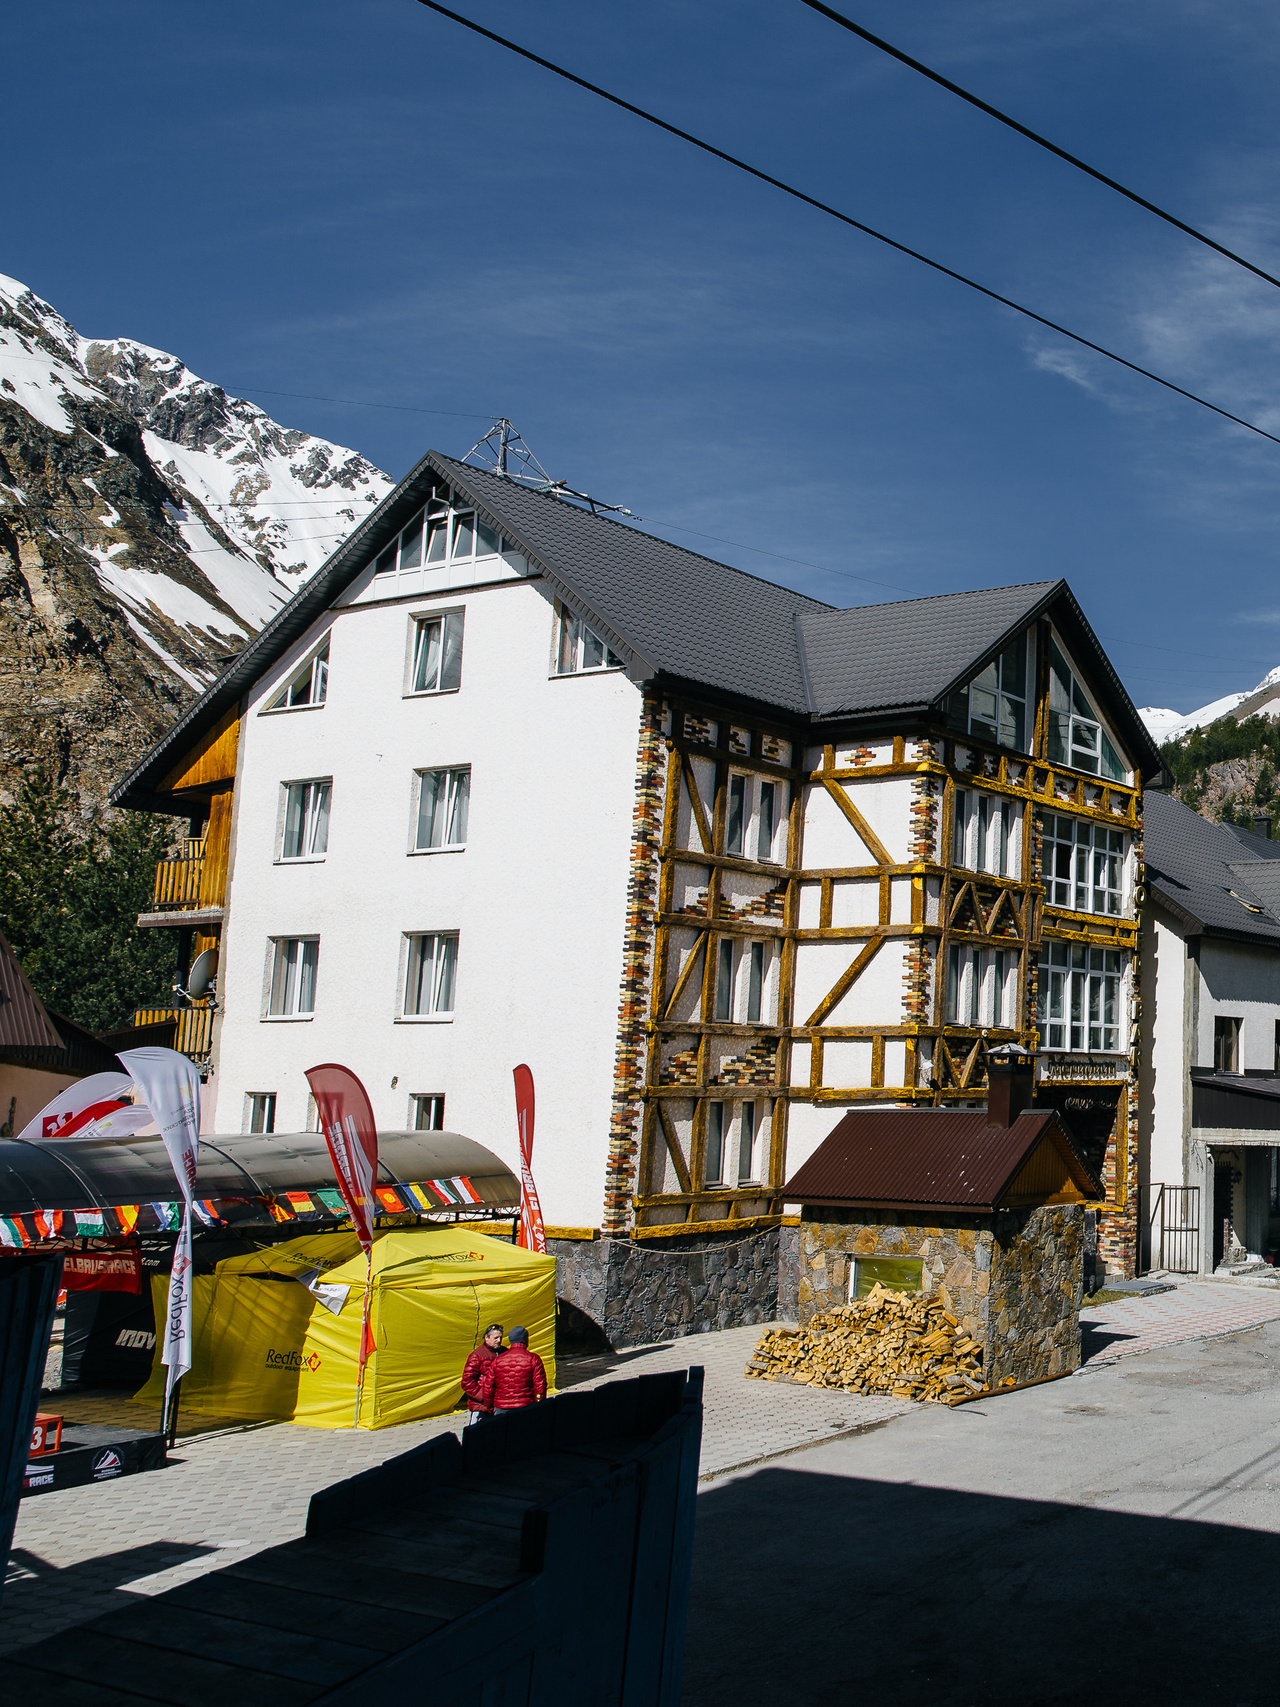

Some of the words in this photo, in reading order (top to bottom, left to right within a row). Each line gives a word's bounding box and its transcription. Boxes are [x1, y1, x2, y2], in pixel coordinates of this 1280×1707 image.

[265, 1362, 284, 1371] outdoor
[266, 1348, 309, 1367] RedFox
[30, 1426, 43, 1451] 3
